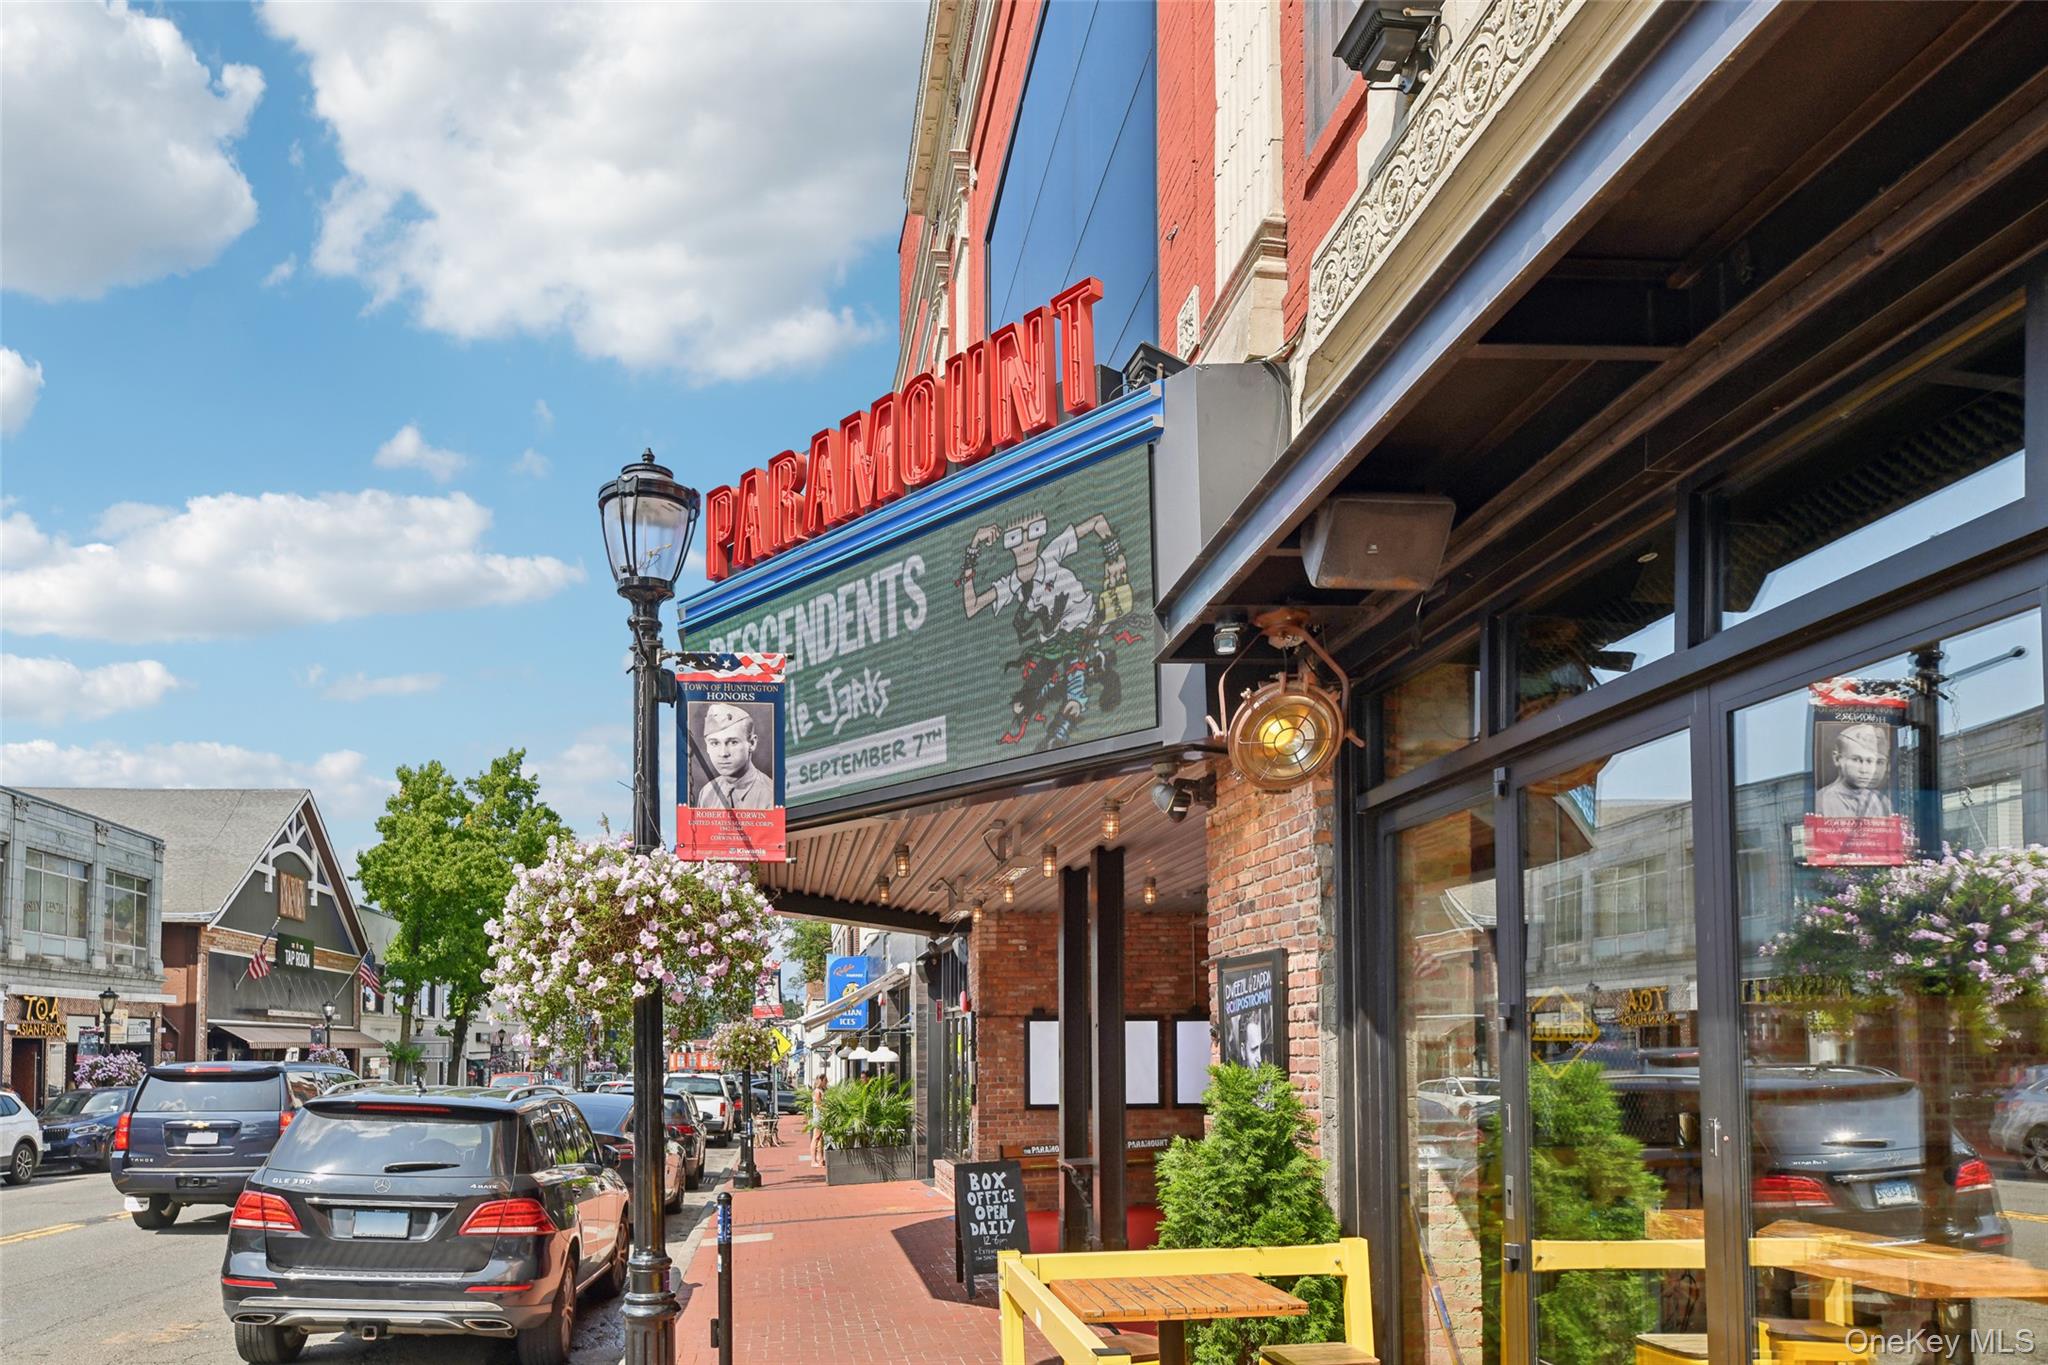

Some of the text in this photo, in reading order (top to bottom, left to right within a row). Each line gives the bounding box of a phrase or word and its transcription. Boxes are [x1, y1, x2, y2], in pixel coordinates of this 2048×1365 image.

[706, 277, 1103, 581] PARAMOUNT
[708, 554, 928, 675] SCENDENTS
[684, 683, 778, 692] TOWN OF HUNTINGTON
[706, 692, 755, 701] HONORS
[799, 738, 907, 785] SEPTEMBER
[912, 727, 942, 758] 7TH
[696, 811, 725, 819] ROBERT
[735, 811, 766, 819] CORWIN
[284, 949, 310, 968] TAP ROOM
[16, 1023, 67, 1036] ASIAN FUSION
[839, 1018, 856, 1026] ICES
[1127, 1138, 1168, 1149] PARAMOUNT
[968, 1171, 1007, 1191] BOX
[967, 1189, 1016, 1206] OFFICE
[975, 1204, 1008, 1220] OPEN
[969, 1219, 1016, 1236] DAILY
